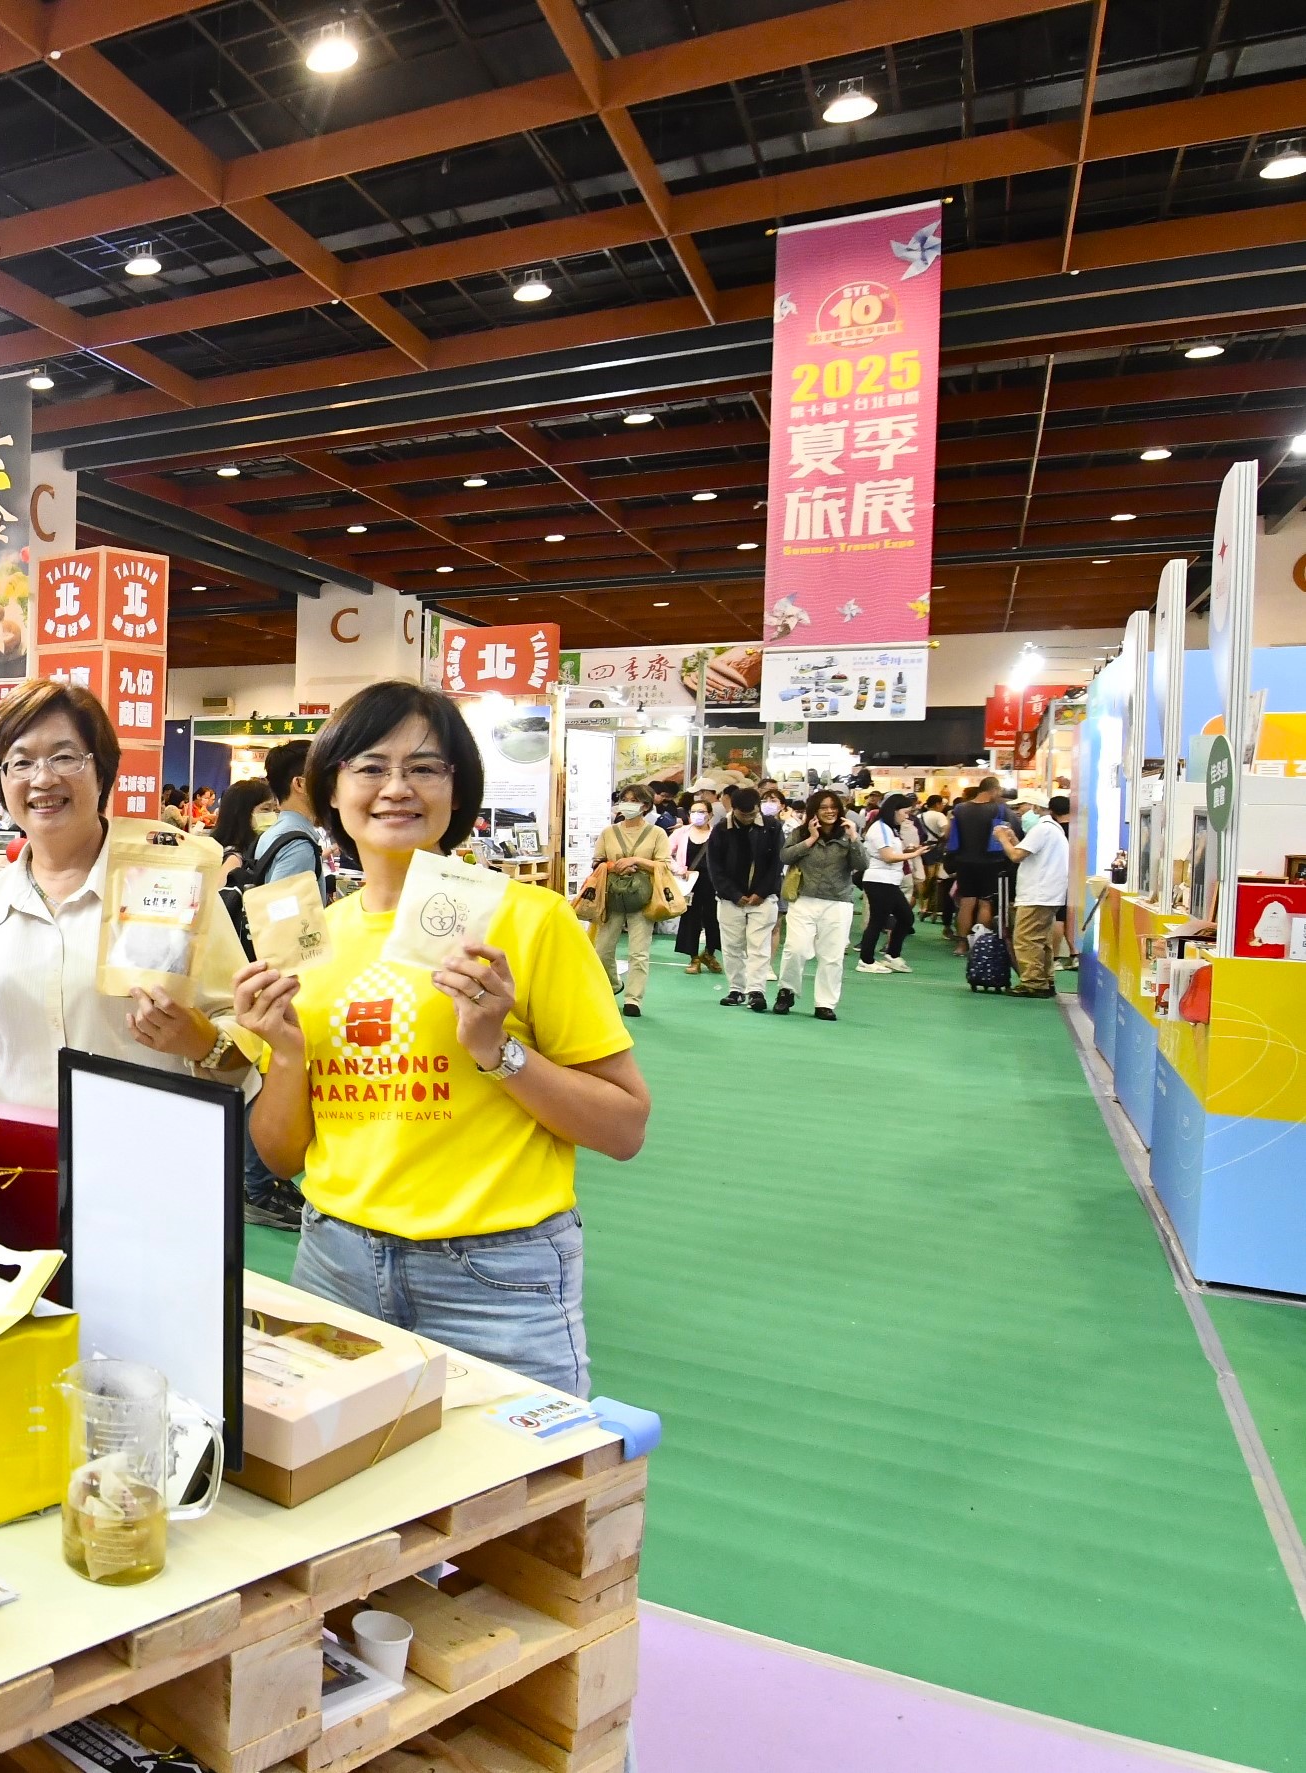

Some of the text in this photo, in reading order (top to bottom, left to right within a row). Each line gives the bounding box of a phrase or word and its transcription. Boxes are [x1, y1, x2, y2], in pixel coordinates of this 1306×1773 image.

[790, 350, 922, 403] 2025
[786, 412, 919, 480] 夏季
[783, 477, 916, 543] 旅展
[783, 539, 915, 556] Summer Travel Expo
[45, 561, 92, 584] TAIWAN
[113, 561, 159, 586] TAIWAN
[55, 582, 80, 618] 北
[123, 581, 148, 618] 北
[330, 607, 360, 644] C
[403, 609, 415, 645] C
[477, 643, 516, 680] 北
[587, 653, 676, 682] 四季齋
[119, 667, 154, 697] 九份
[118, 700, 153, 728] 商圈
[127, 796, 146, 813] 商圈
[316, 1110, 452, 1121] AIWAN'S RICE HEAVEN
